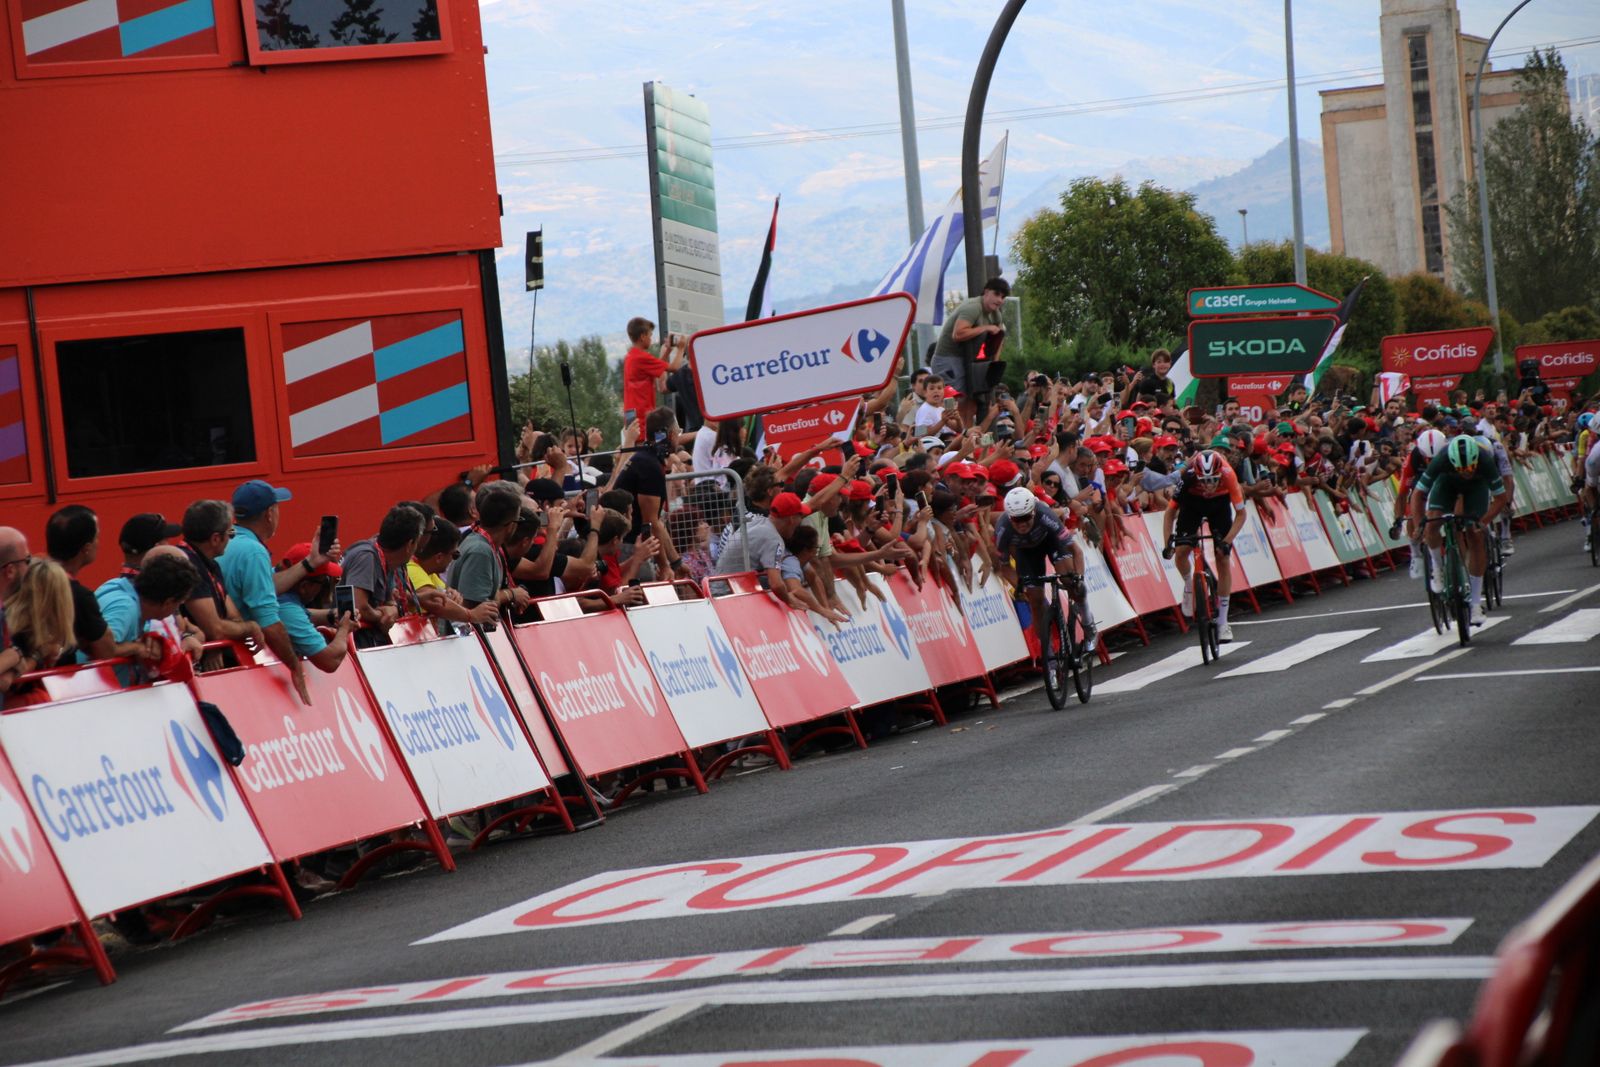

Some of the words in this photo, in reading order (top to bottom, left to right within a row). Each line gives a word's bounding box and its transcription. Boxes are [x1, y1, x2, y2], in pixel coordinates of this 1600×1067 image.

[1204, 294, 1246, 308] caser
[1245, 299, 1267, 307] Grupo
[711, 348, 831, 386] Carrefour
[1413, 343, 1478, 361] Cofidis
[1541, 352, 1594, 367] Cofidis
[768, 417, 820, 435] Carrefour
[1240, 405, 1263, 423] 50
[906, 599, 950, 644] arrefour
[649, 644, 719, 699] Carrefour
[734, 629, 799, 682] Carrefour
[540, 660, 626, 723] Carrefour
[385, 689, 481, 758] Carrefour
[31, 754, 175, 843] Carrefour
[513, 812, 1537, 928] COFIDIS
